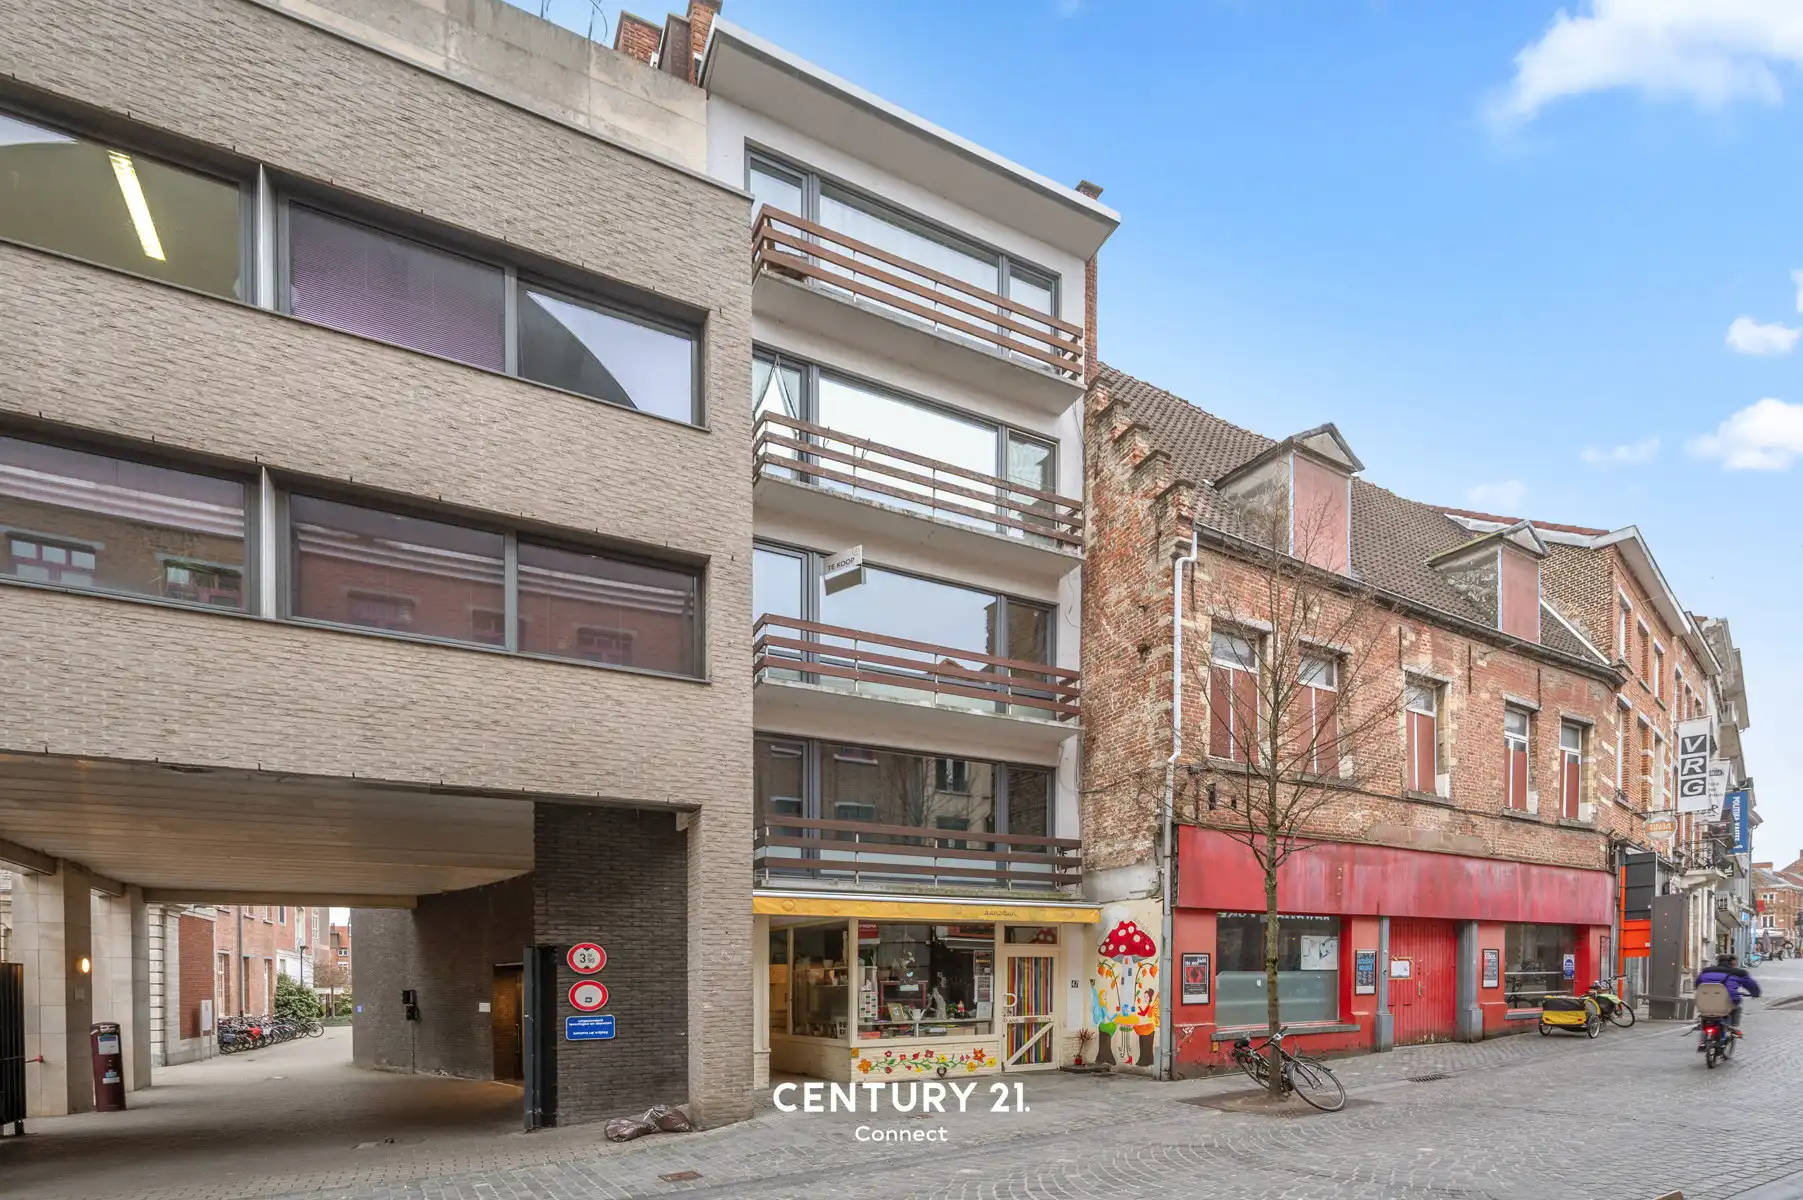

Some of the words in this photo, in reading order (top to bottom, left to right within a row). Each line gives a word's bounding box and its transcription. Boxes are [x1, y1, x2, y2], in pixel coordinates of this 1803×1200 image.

[828, 563, 835, 571] TE
[837, 557, 855, 568] KOOP
[1682, 735, 1706, 796] VRG
[580, 953, 586, 963] 3
